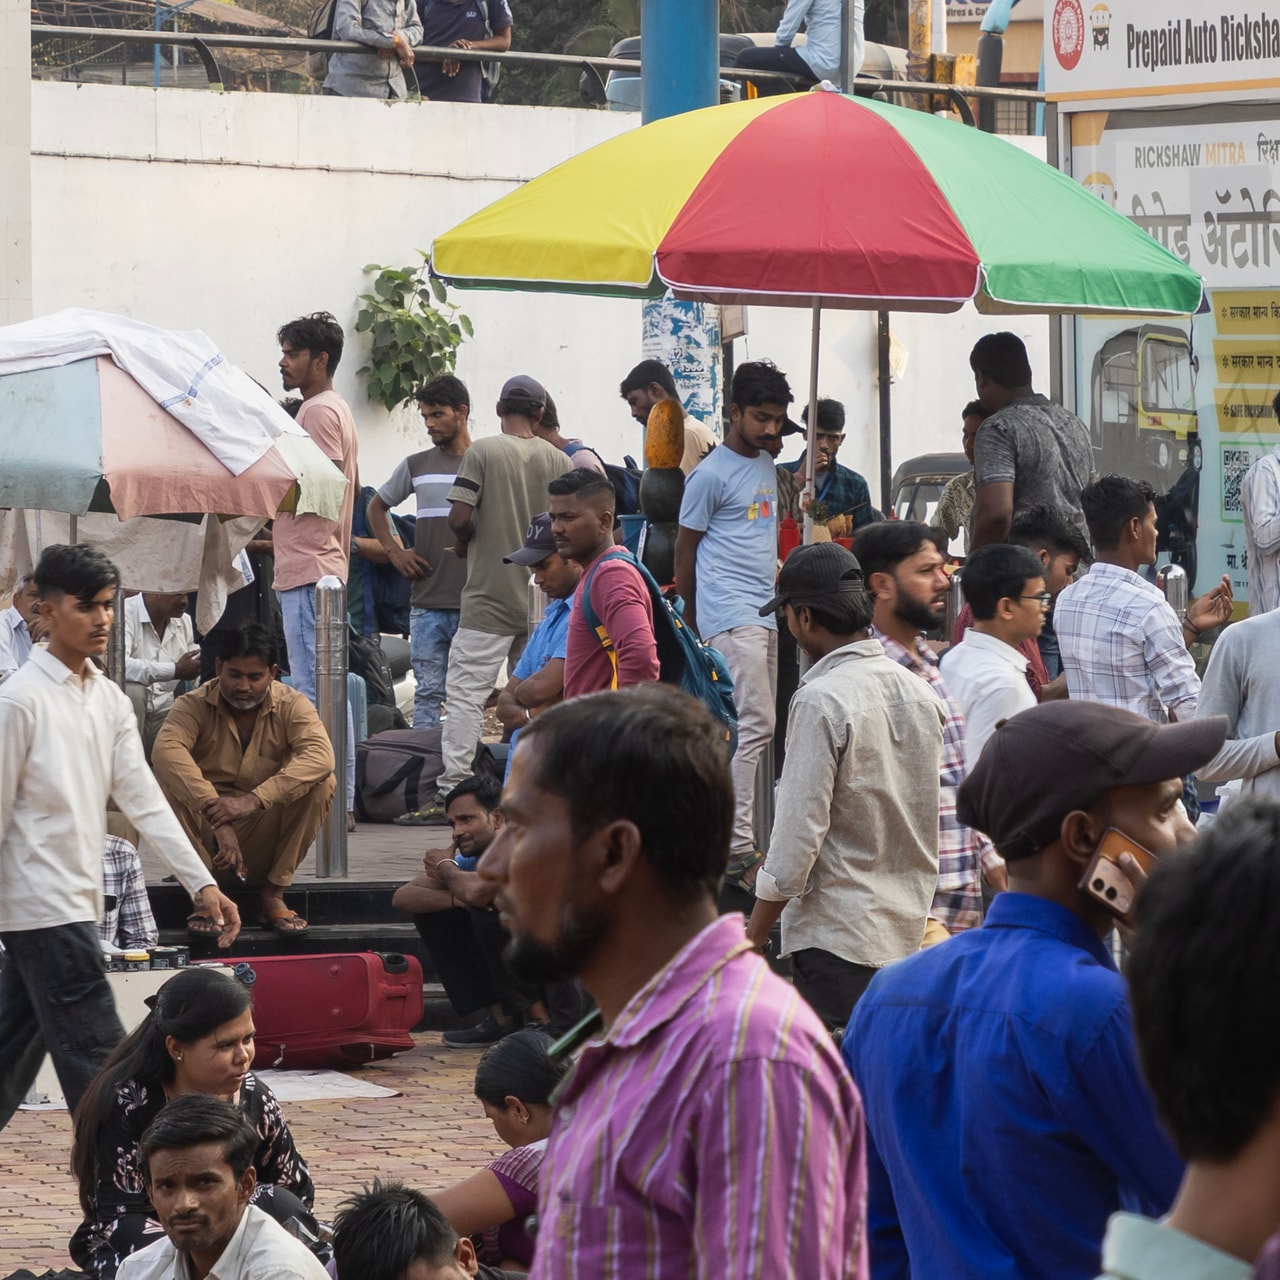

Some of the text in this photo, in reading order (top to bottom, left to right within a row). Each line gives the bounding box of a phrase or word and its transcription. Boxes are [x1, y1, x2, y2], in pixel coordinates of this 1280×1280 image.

[970, 7, 975, 16] &
[1126, 19, 1182, 72] Prepaid
[1185, 17, 1217, 65] Auto
[1134, 141, 1246, 169] RICKSHAW MITRA
